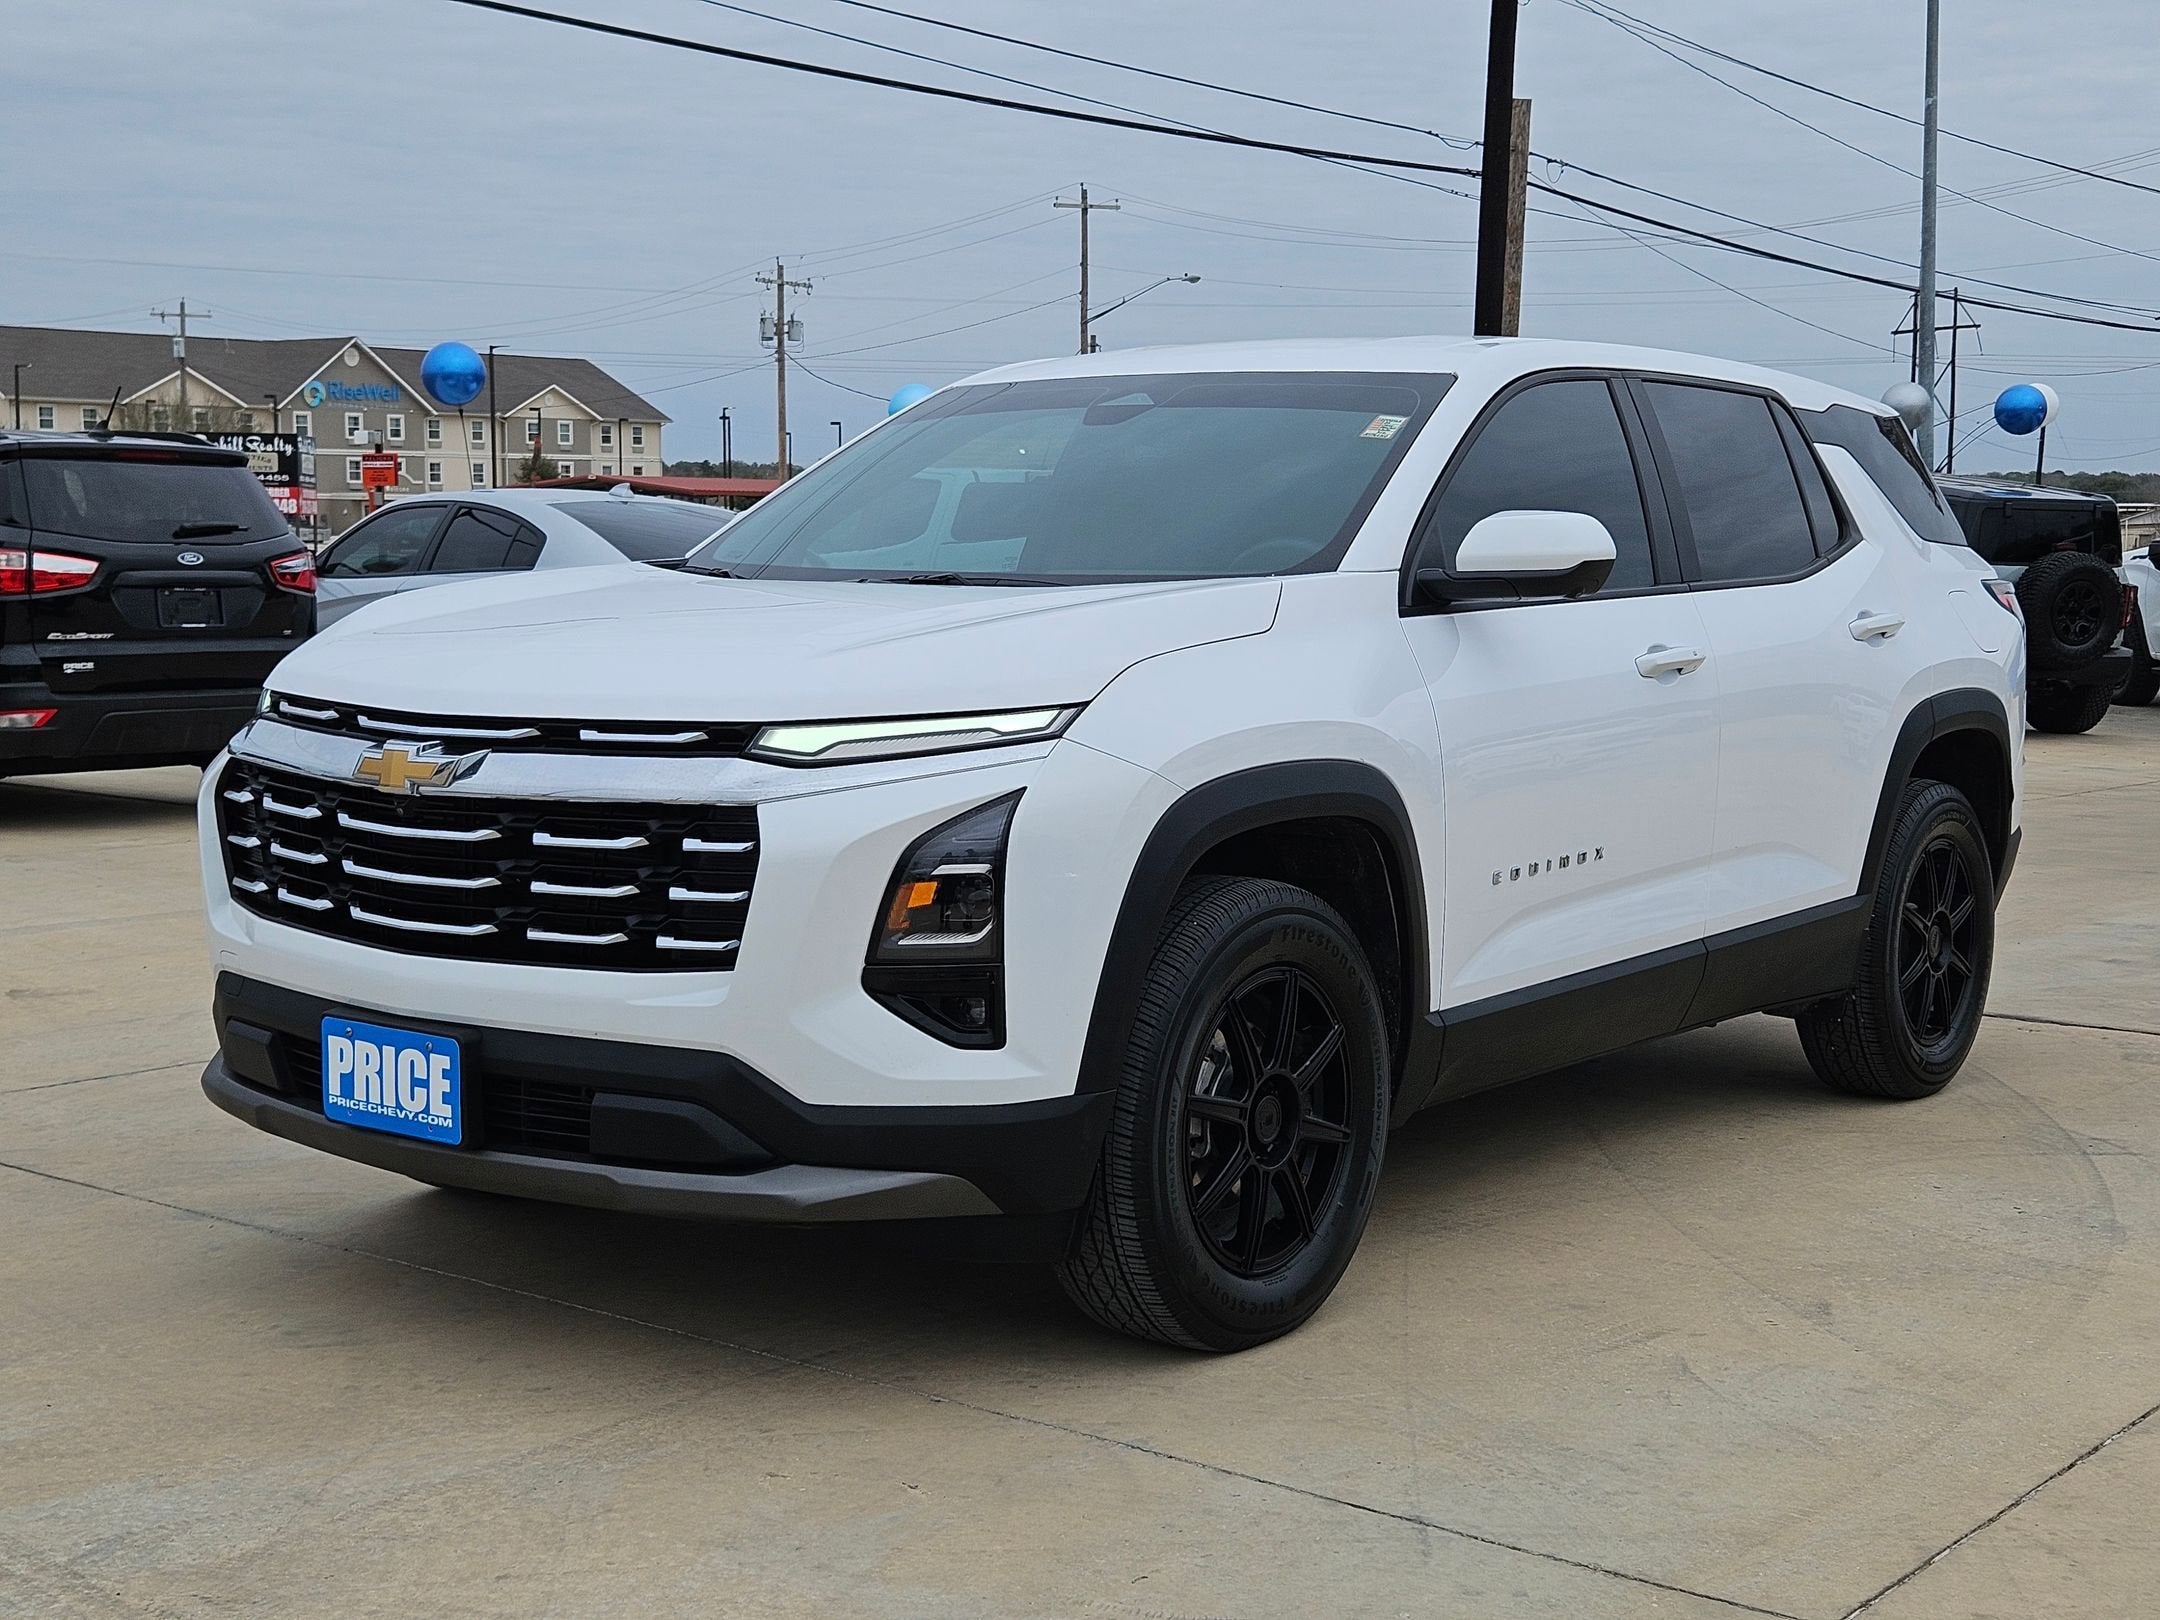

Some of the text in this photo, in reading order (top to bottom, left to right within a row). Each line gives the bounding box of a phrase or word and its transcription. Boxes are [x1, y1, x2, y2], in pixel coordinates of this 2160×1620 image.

[328, 381, 400, 402] RiseWell
[63, 662, 95, 670] PRICE
[1491, 846, 1605, 886] EQUINOX
[1280, 924, 1357, 977] Firestone
[327, 1034, 452, 1118] PRICE
[328, 1095, 453, 1128] PRICECHEVY.COM
